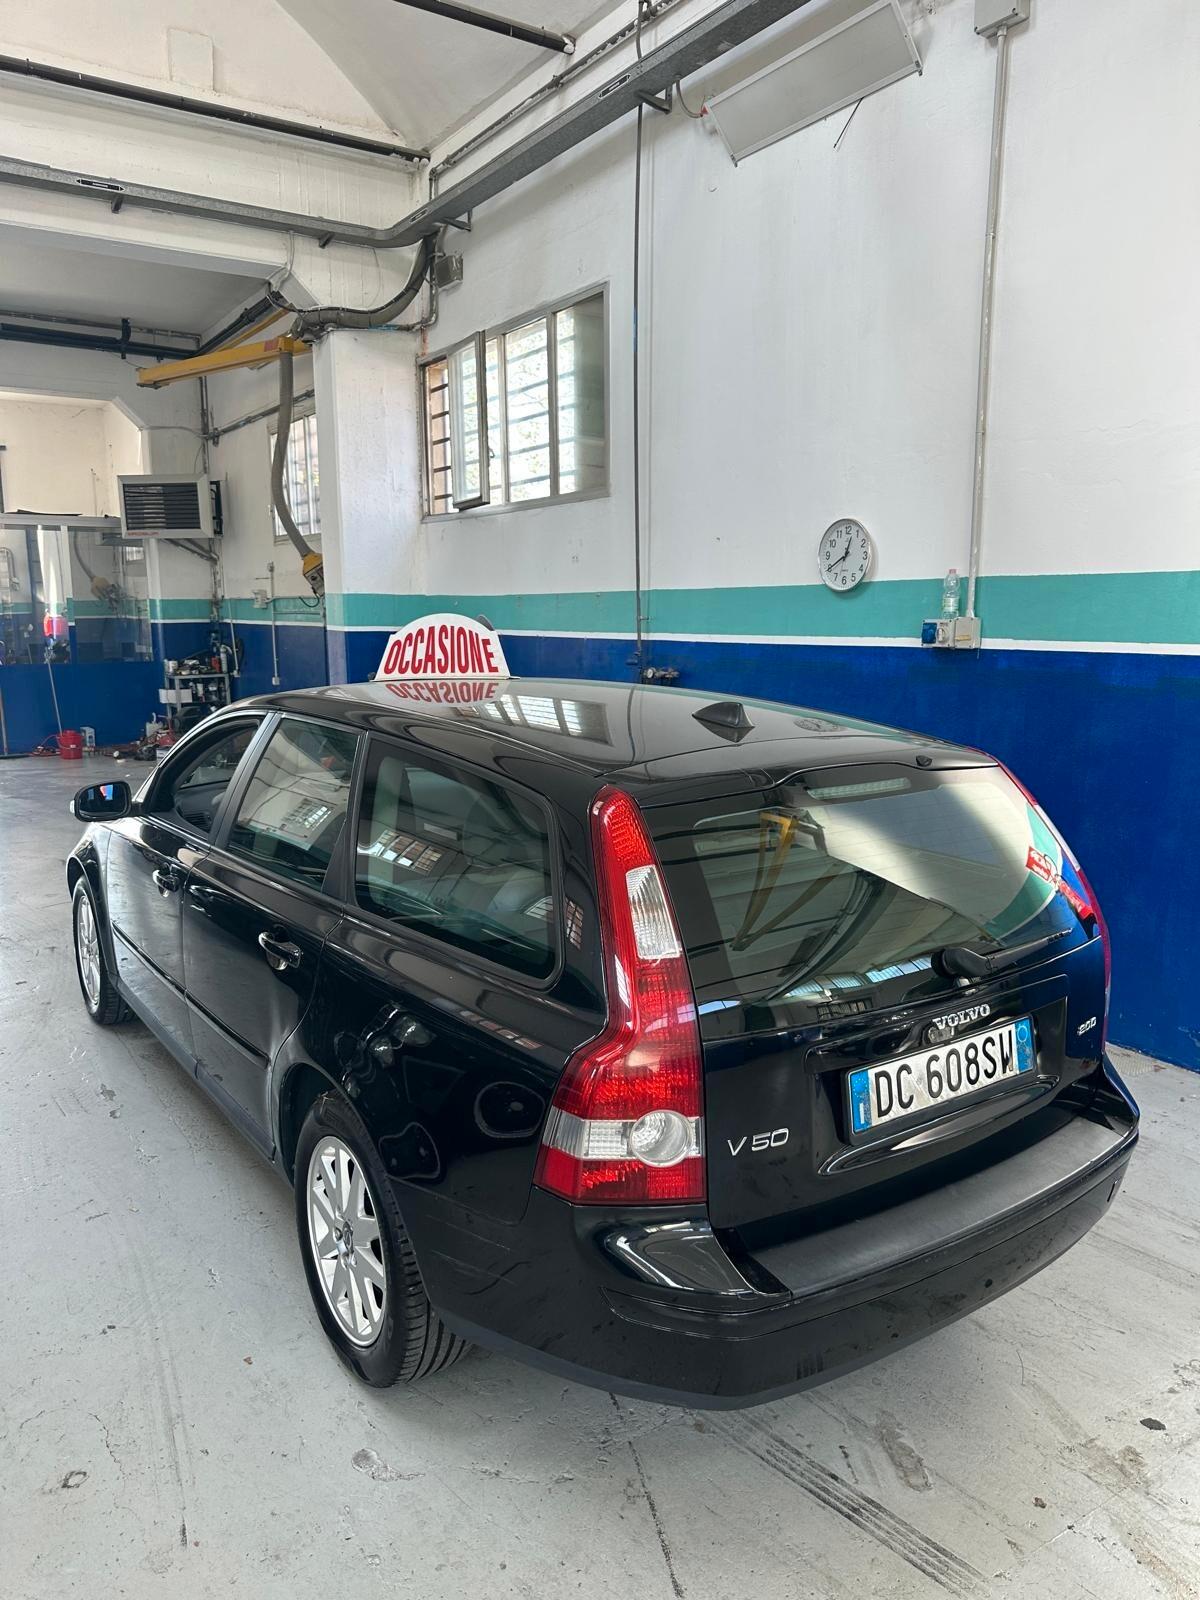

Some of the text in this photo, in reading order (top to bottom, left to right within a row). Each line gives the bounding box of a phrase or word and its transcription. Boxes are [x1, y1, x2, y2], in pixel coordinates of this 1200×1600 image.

[836, 530, 842, 539] 11
[845, 525, 853, 535] 12
[829, 539, 837, 548] 10
[860, 538, 866, 548] 2
[825, 550, 831, 560] 9
[862, 550, 868, 560] 3
[827, 563, 833, 573] 8
[858, 564, 864, 573] 4
[833, 572, 839, 581] 7
[841, 575, 847, 585] 6
[850, 572, 857, 582] 5
[383, 624, 499, 675] OCCASIONE
[932, 1003, 991, 1031] VOLVO
[874, 1029, 1014, 1118] DC 608SW
